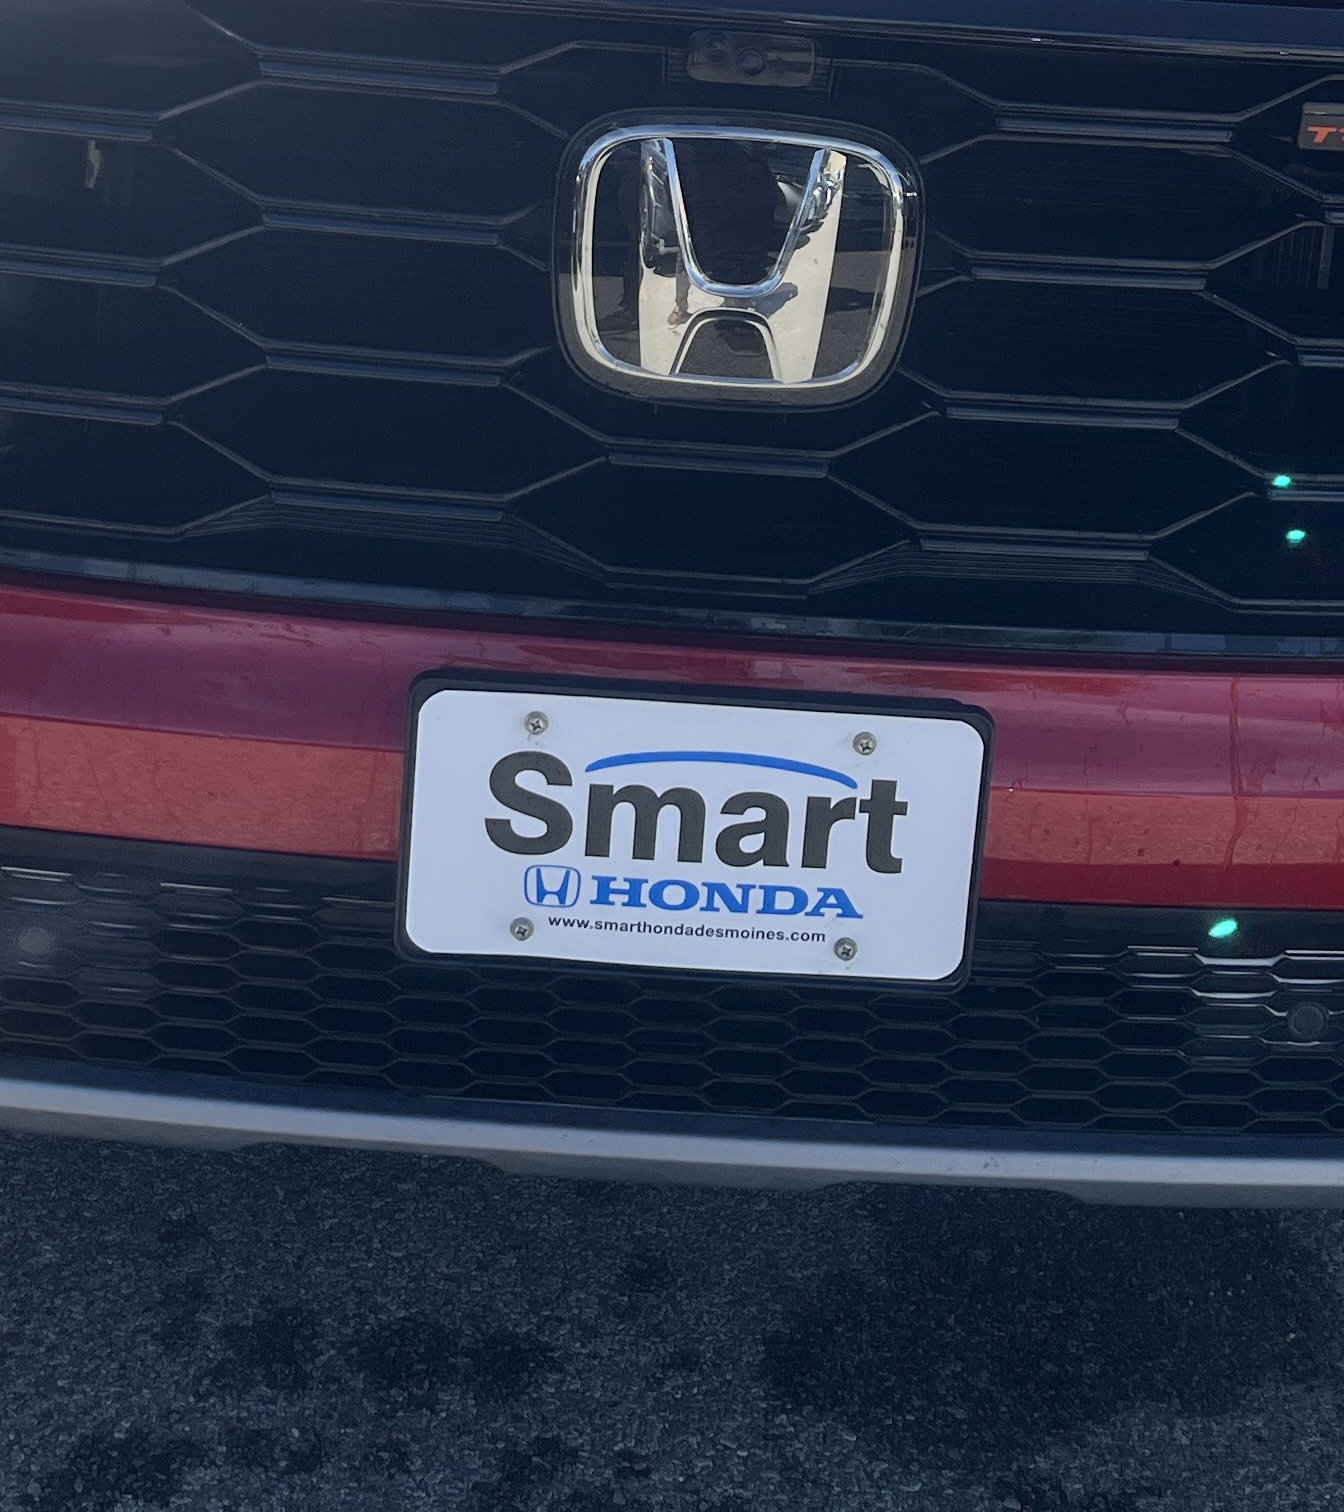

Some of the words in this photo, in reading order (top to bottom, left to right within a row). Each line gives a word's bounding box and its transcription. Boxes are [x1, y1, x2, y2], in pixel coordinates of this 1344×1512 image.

[484, 750, 909, 875] Smart
[589, 875, 864, 920] HONDA
[547, 916, 827, 944] www.smarthondadesmoines.com
